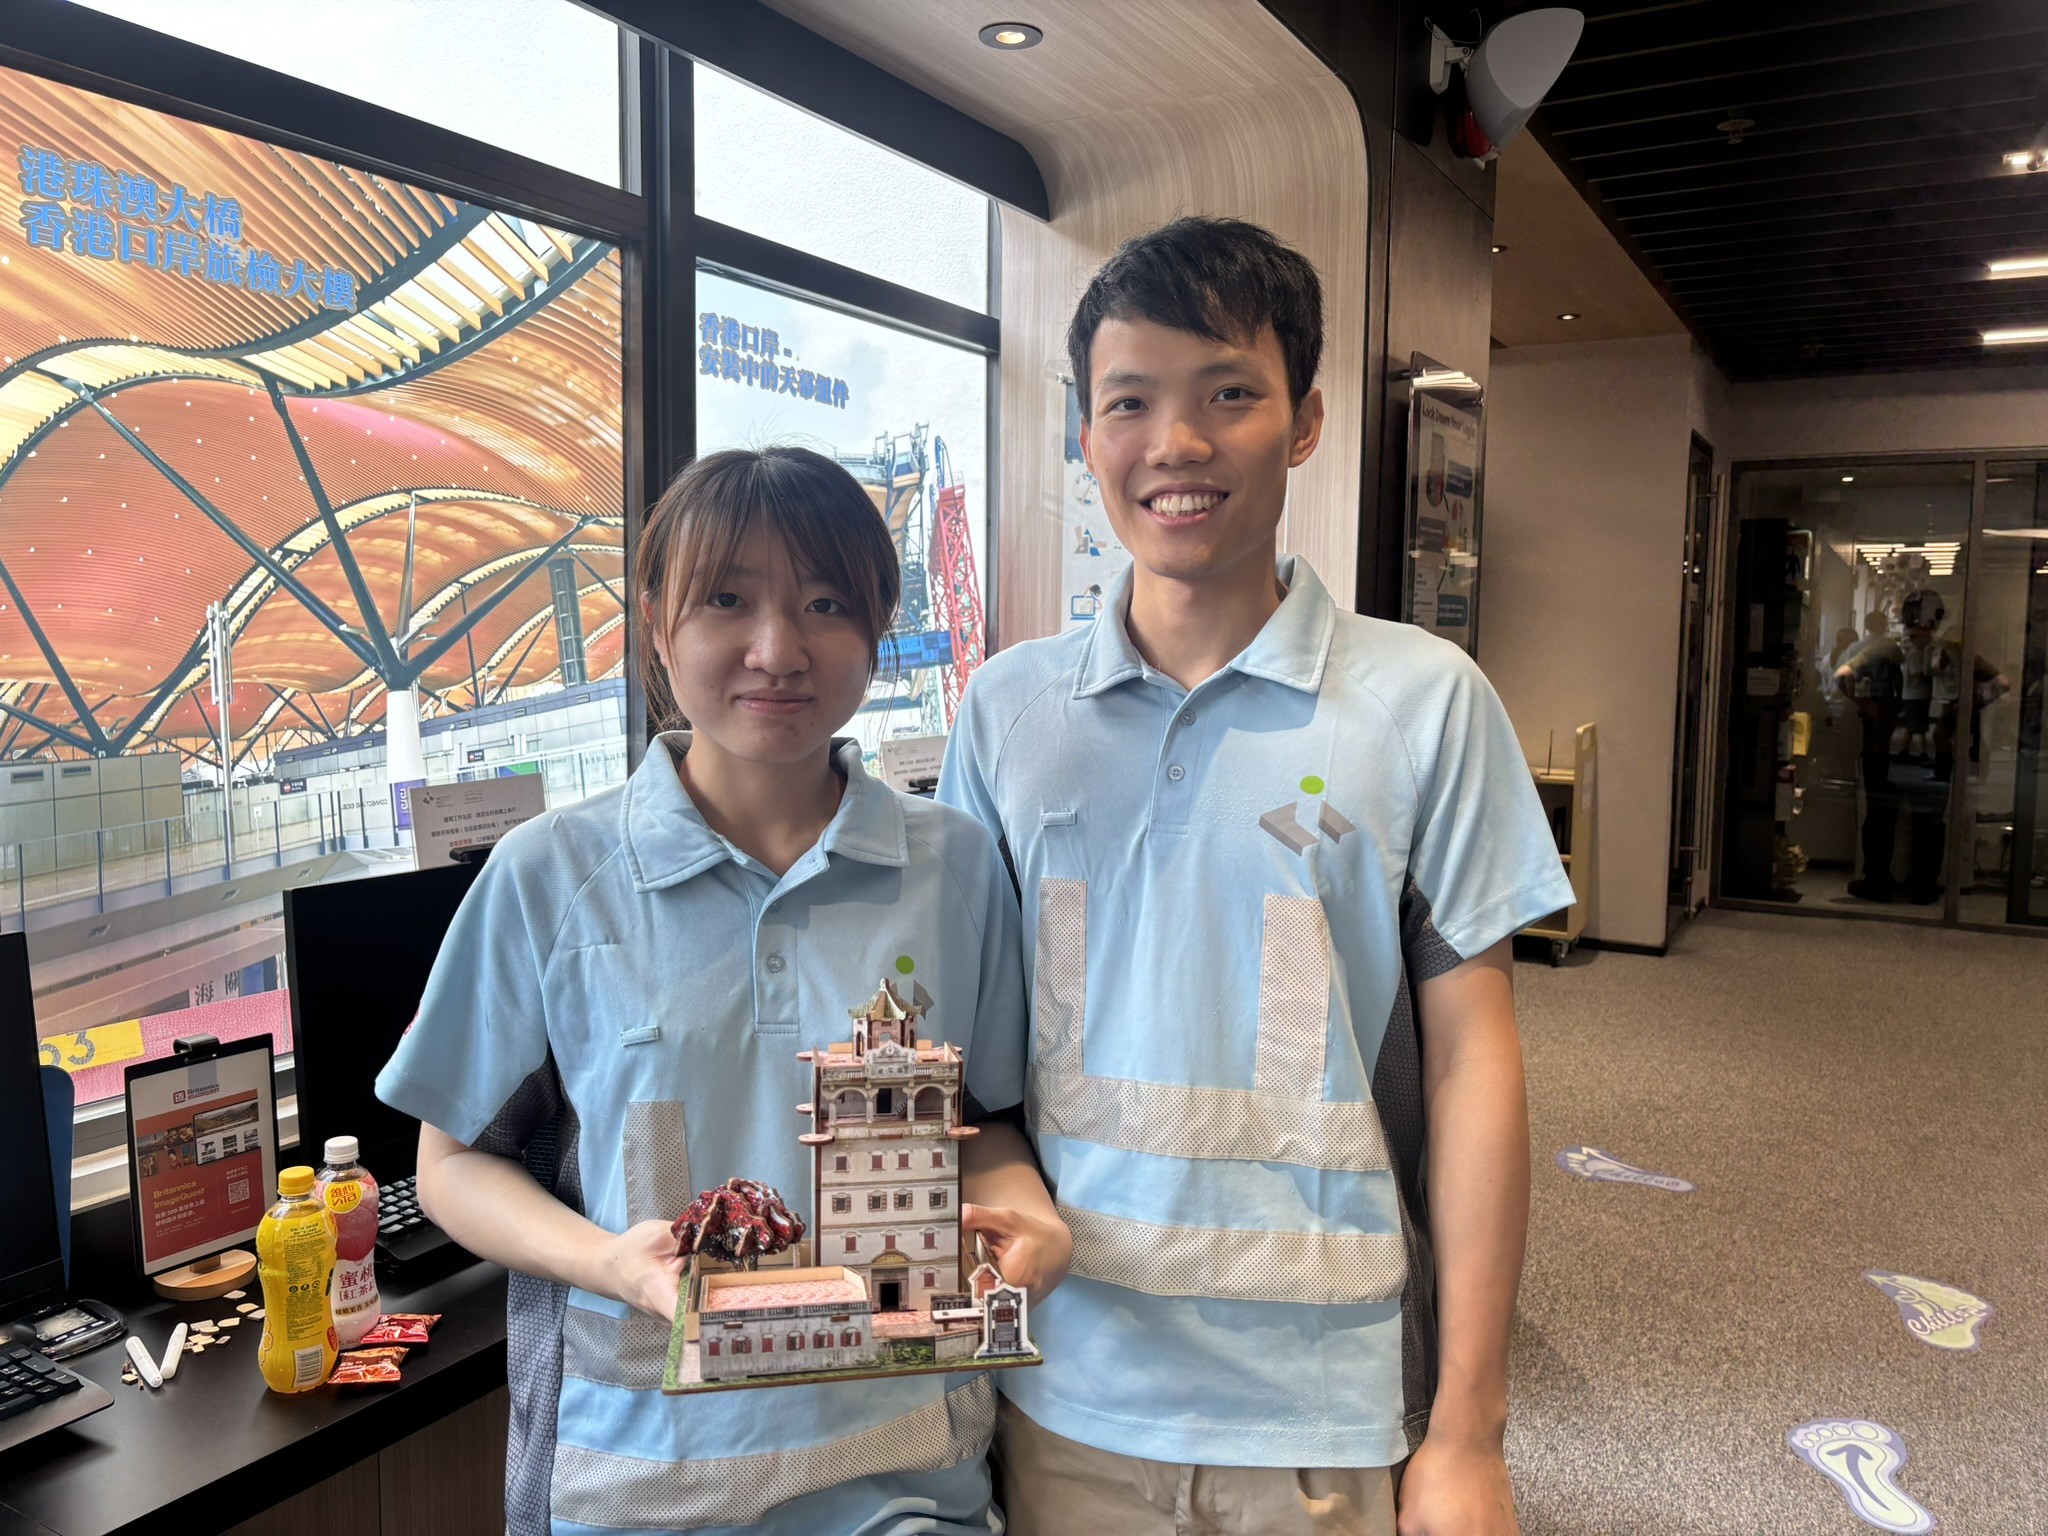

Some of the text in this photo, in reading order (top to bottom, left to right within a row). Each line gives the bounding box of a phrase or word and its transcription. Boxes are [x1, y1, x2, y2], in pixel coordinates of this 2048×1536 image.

[18, 144, 244, 243] 港珠澳大橋
[21, 201, 358, 312] 香港口岸旅檢大樓
[700, 312, 779, 360] 香港口岸
[699, 343, 849, 409] 安裝中的天幕組件
[153, 1181, 197, 1198] Britannica
[154, 1187, 205, 1208] ImageQuest
[330, 1184, 355, 1198] 維他
[339, 1262, 373, 1289] 蜜桃
